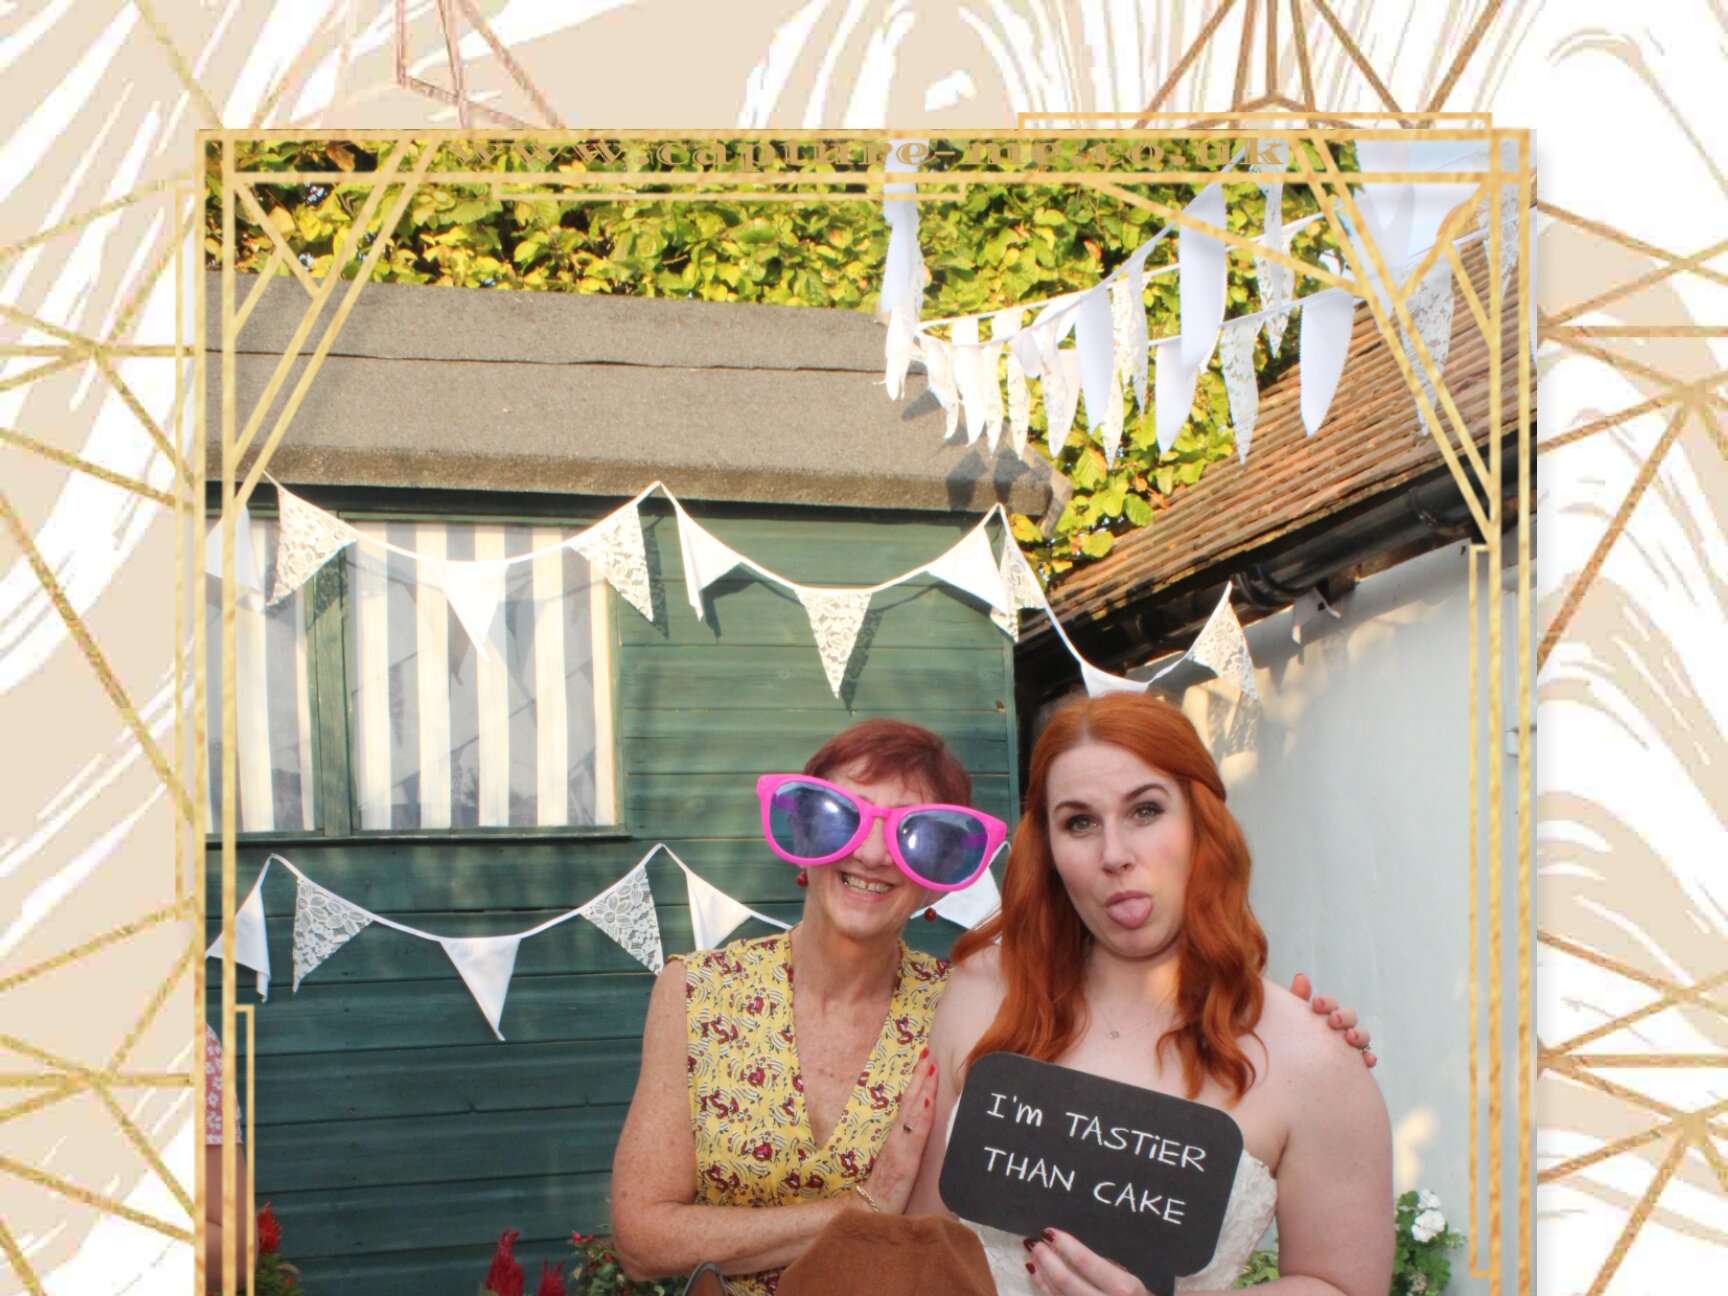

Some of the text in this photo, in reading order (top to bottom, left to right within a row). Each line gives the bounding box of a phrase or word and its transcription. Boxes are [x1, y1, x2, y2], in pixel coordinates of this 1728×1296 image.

[986, 1092, 1043, 1127] I'm
[983, 1146, 1187, 1226] THAN CAKE
